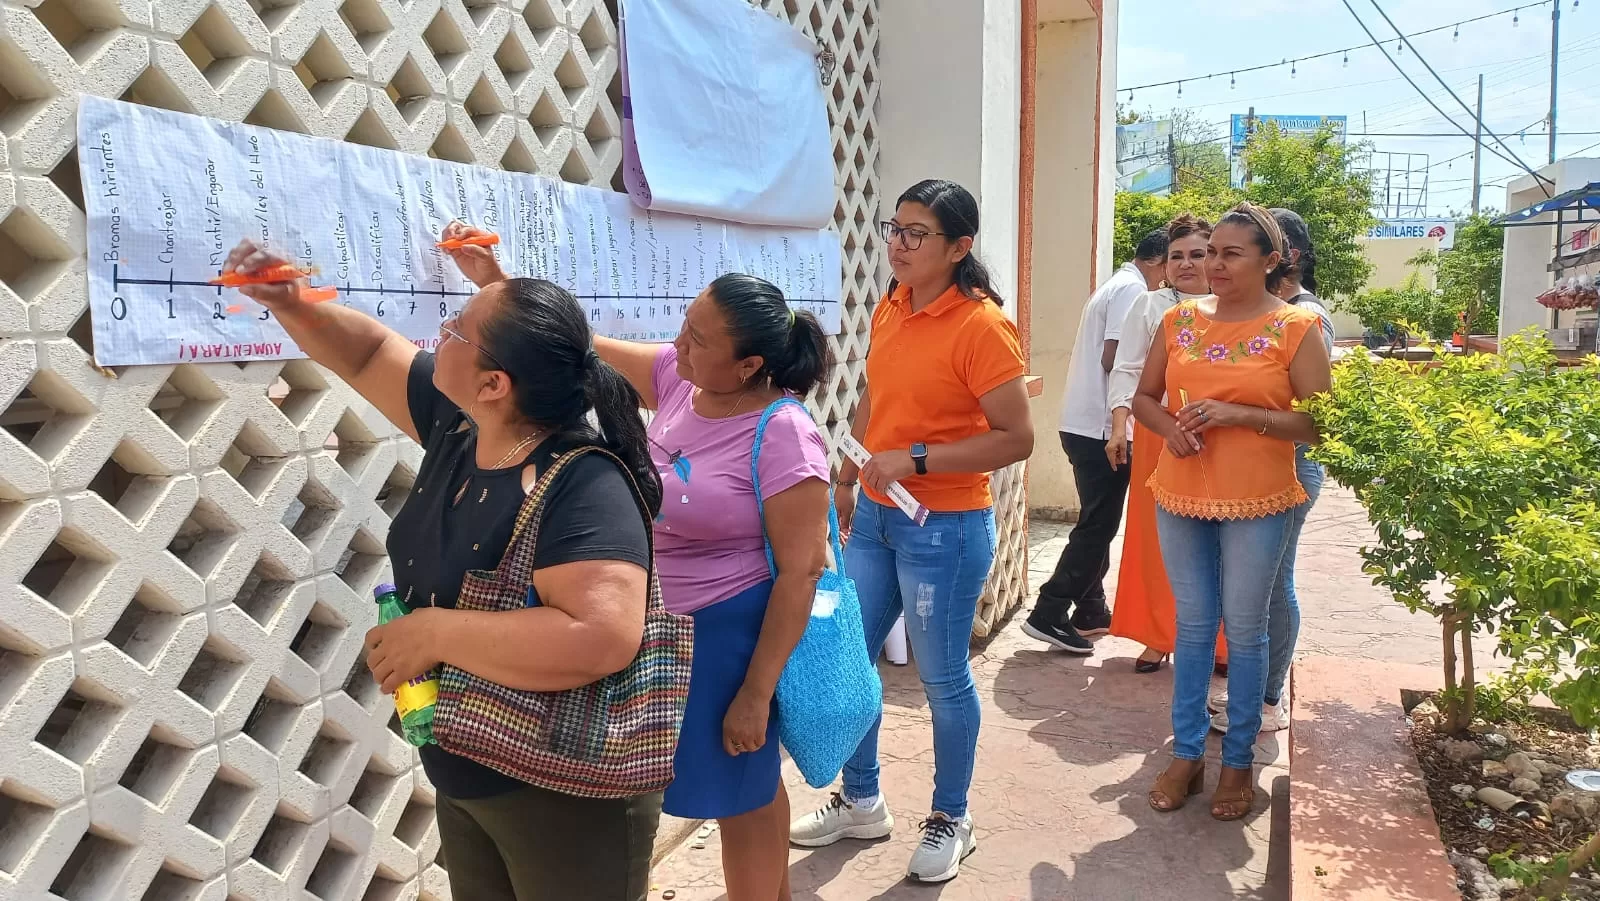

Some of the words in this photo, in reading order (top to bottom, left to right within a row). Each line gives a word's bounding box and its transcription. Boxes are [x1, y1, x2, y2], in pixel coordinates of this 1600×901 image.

[250, 170, 264, 190] del
[420, 180, 441, 220] público
[104, 206, 120, 262] Bromas
[431, 223, 439, 235] en
[604, 216, 620, 255] jugando
[1376, 226, 1424, 237] SIMILARES
[369, 211, 383, 282] Descalificar
[566, 227, 577, 291] Manosear
[610, 257, 622, 290] Golpear
[111, 297, 127, 320] 0
[165, 299, 176, 319] 1
[213, 302, 226, 321] 2
[377, 301, 385, 317] 6
[409, 302, 418, 315] 7
[439, 302, 447, 317] 8
[663, 304, 671, 316] 18
